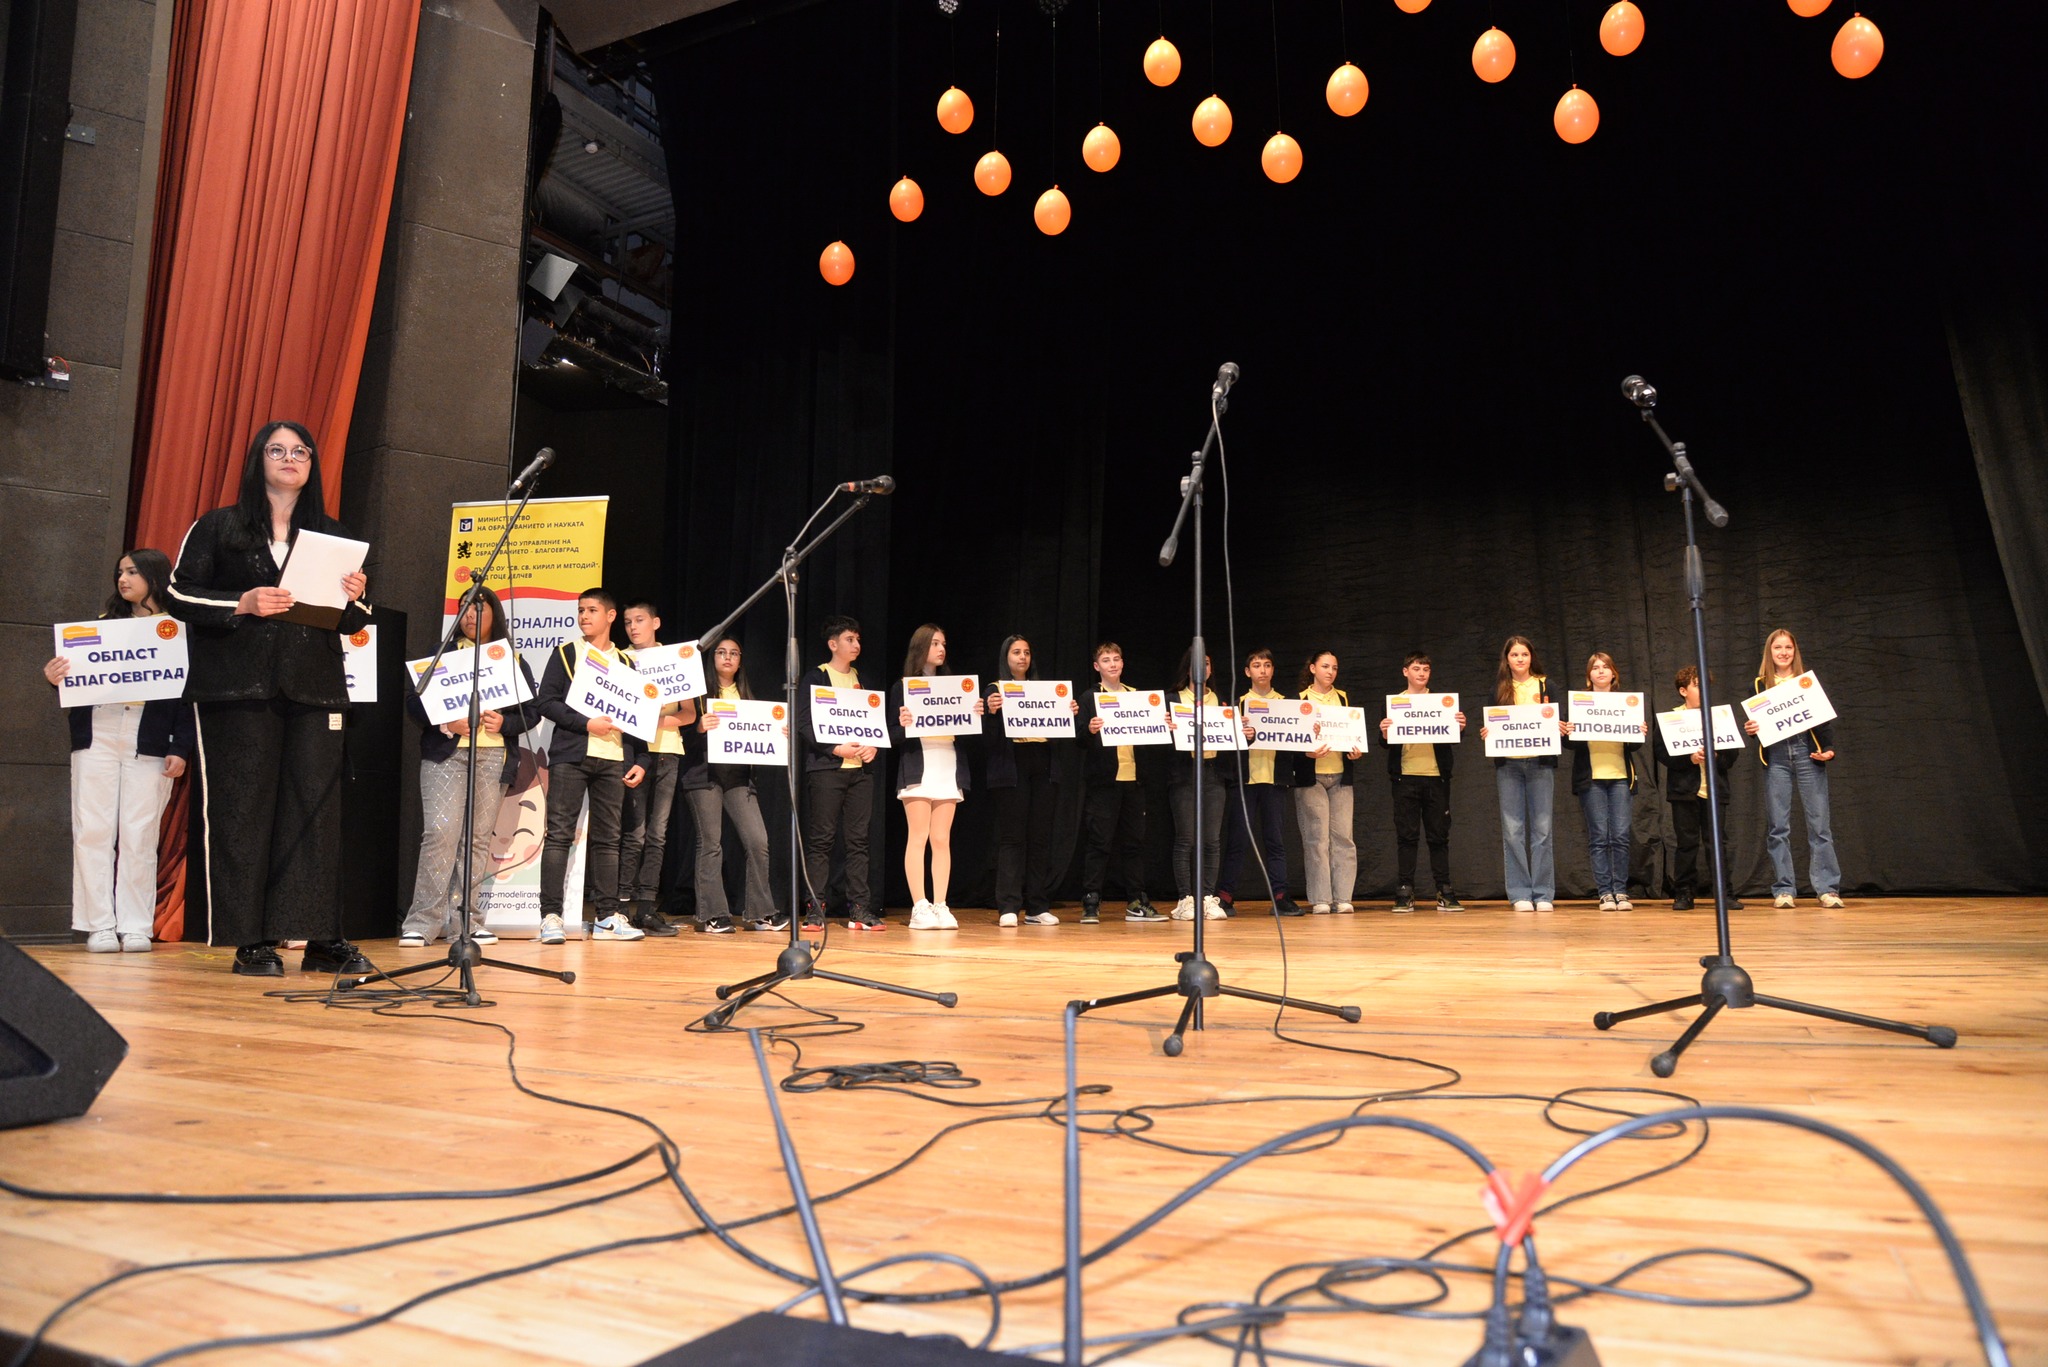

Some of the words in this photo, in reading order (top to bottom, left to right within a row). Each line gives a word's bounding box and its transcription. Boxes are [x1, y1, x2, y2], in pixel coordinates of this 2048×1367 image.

[478, 515, 531, 523] МИНИСТЕРТВО
[488, 523, 545, 531] ОБРАВАНИЕТО
[519, 539, 560, 547] УПРАВЛЕНИЕ
[475, 549, 529, 557] ОБРАВАНИЕТО
[88, 647, 158, 663] ОБЛАСТ
[64, 667, 185, 688] БЛАГОЕВГРАД
[595, 676, 640, 704] ОБЛАСТ
[443, 683, 509, 711] ВИИН
[922, 696, 962, 706] ОБЛАСТ
[584, 692, 638, 727] ВАРНА
[1018, 700, 1056, 709] ОБЛАСТ
[1766, 694, 1805, 715] ОБЛАСТ
[829, 707, 869, 719] ОБЛАСТ
[1114, 710, 1150, 718] ОБЛАСТ
[1404, 710, 1442, 718] ОБЛАСТ
[1586, 708, 1626, 716] ОБЛАСТ
[915, 713, 972, 728] ДОБРИЧ
[1007, 717, 1071, 728] КЪРДЖАЛИ
[1188, 720, 1225, 728] ОЛАСТ
[1261, 716, 1300, 725] ОБЛАСТ
[1775, 709, 1813, 731] РУСЕ
[728, 722, 772, 732] ОБЛАСТ
[819, 724, 884, 739] ГАБРОВО
[1103, 725, 1167, 735] КЮСТЕНДИЛ
[1397, 725, 1450, 736] ПЕРНИК
[1502, 722, 1542, 731] ОБЛАСТ
[1573, 722, 1641, 734] ПЛОВДИВ
[1255, 731, 1313, 744] ОНТАНА
[1495, 737, 1551, 749] ПЛЕВЕН
[1672, 734, 1735, 749] РАЗГАД
[723, 741, 776, 755] ВРАЦА
